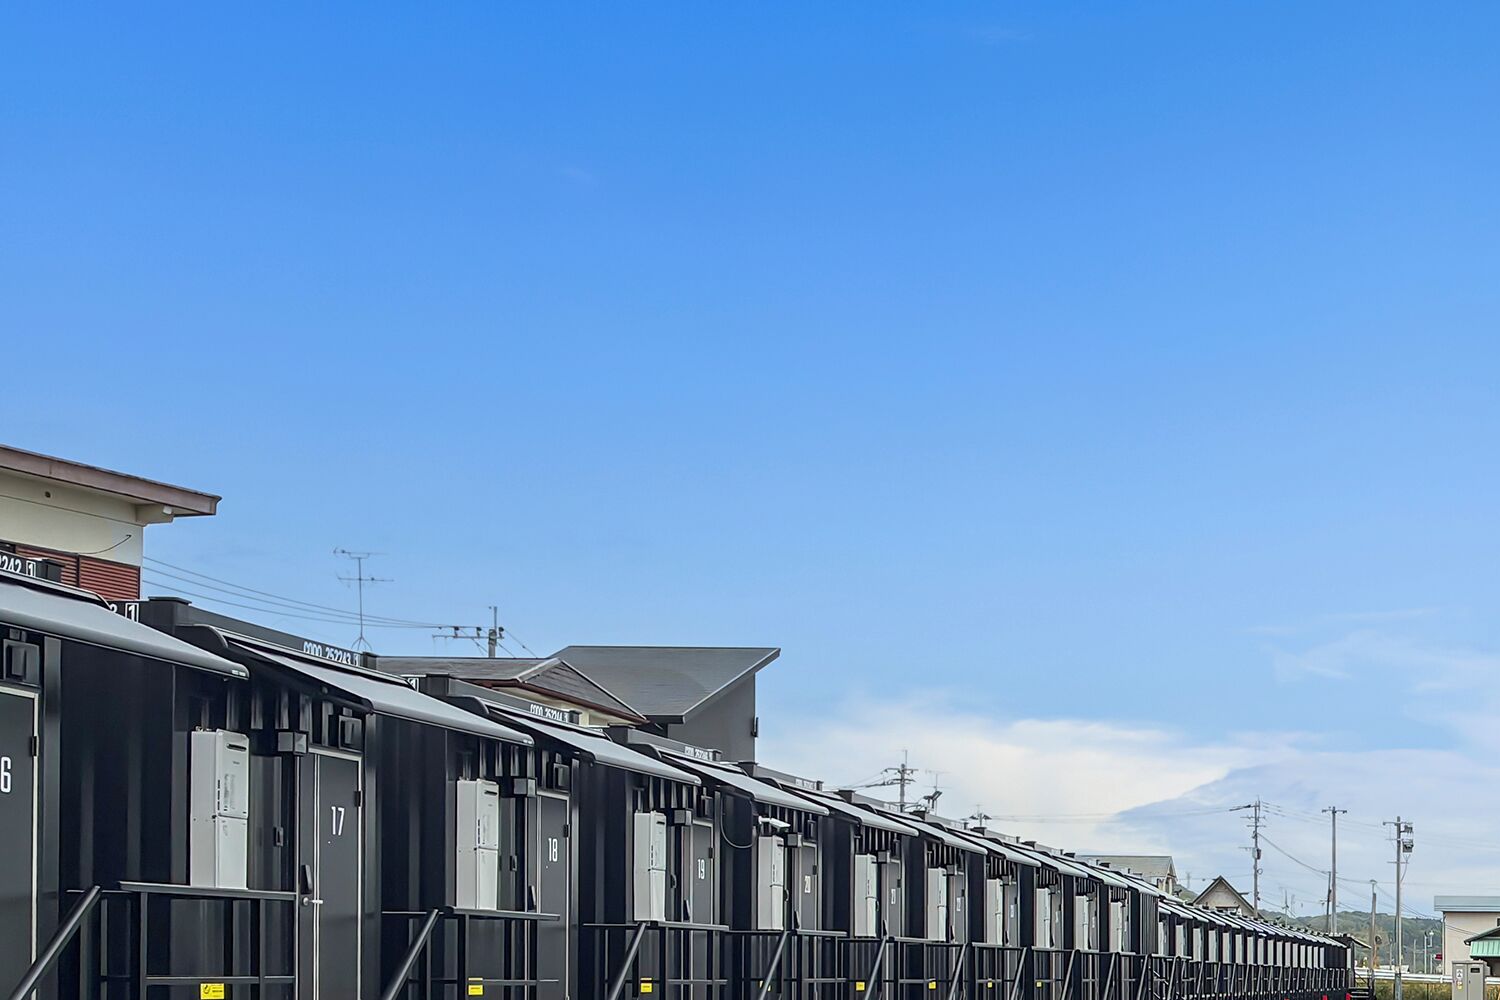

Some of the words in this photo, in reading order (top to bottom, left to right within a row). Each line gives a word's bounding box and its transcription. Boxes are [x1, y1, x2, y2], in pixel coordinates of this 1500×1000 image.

[331, 806, 345, 836] 17
[548, 838, 558, 862] 18
[697, 859, 705, 880] 19
